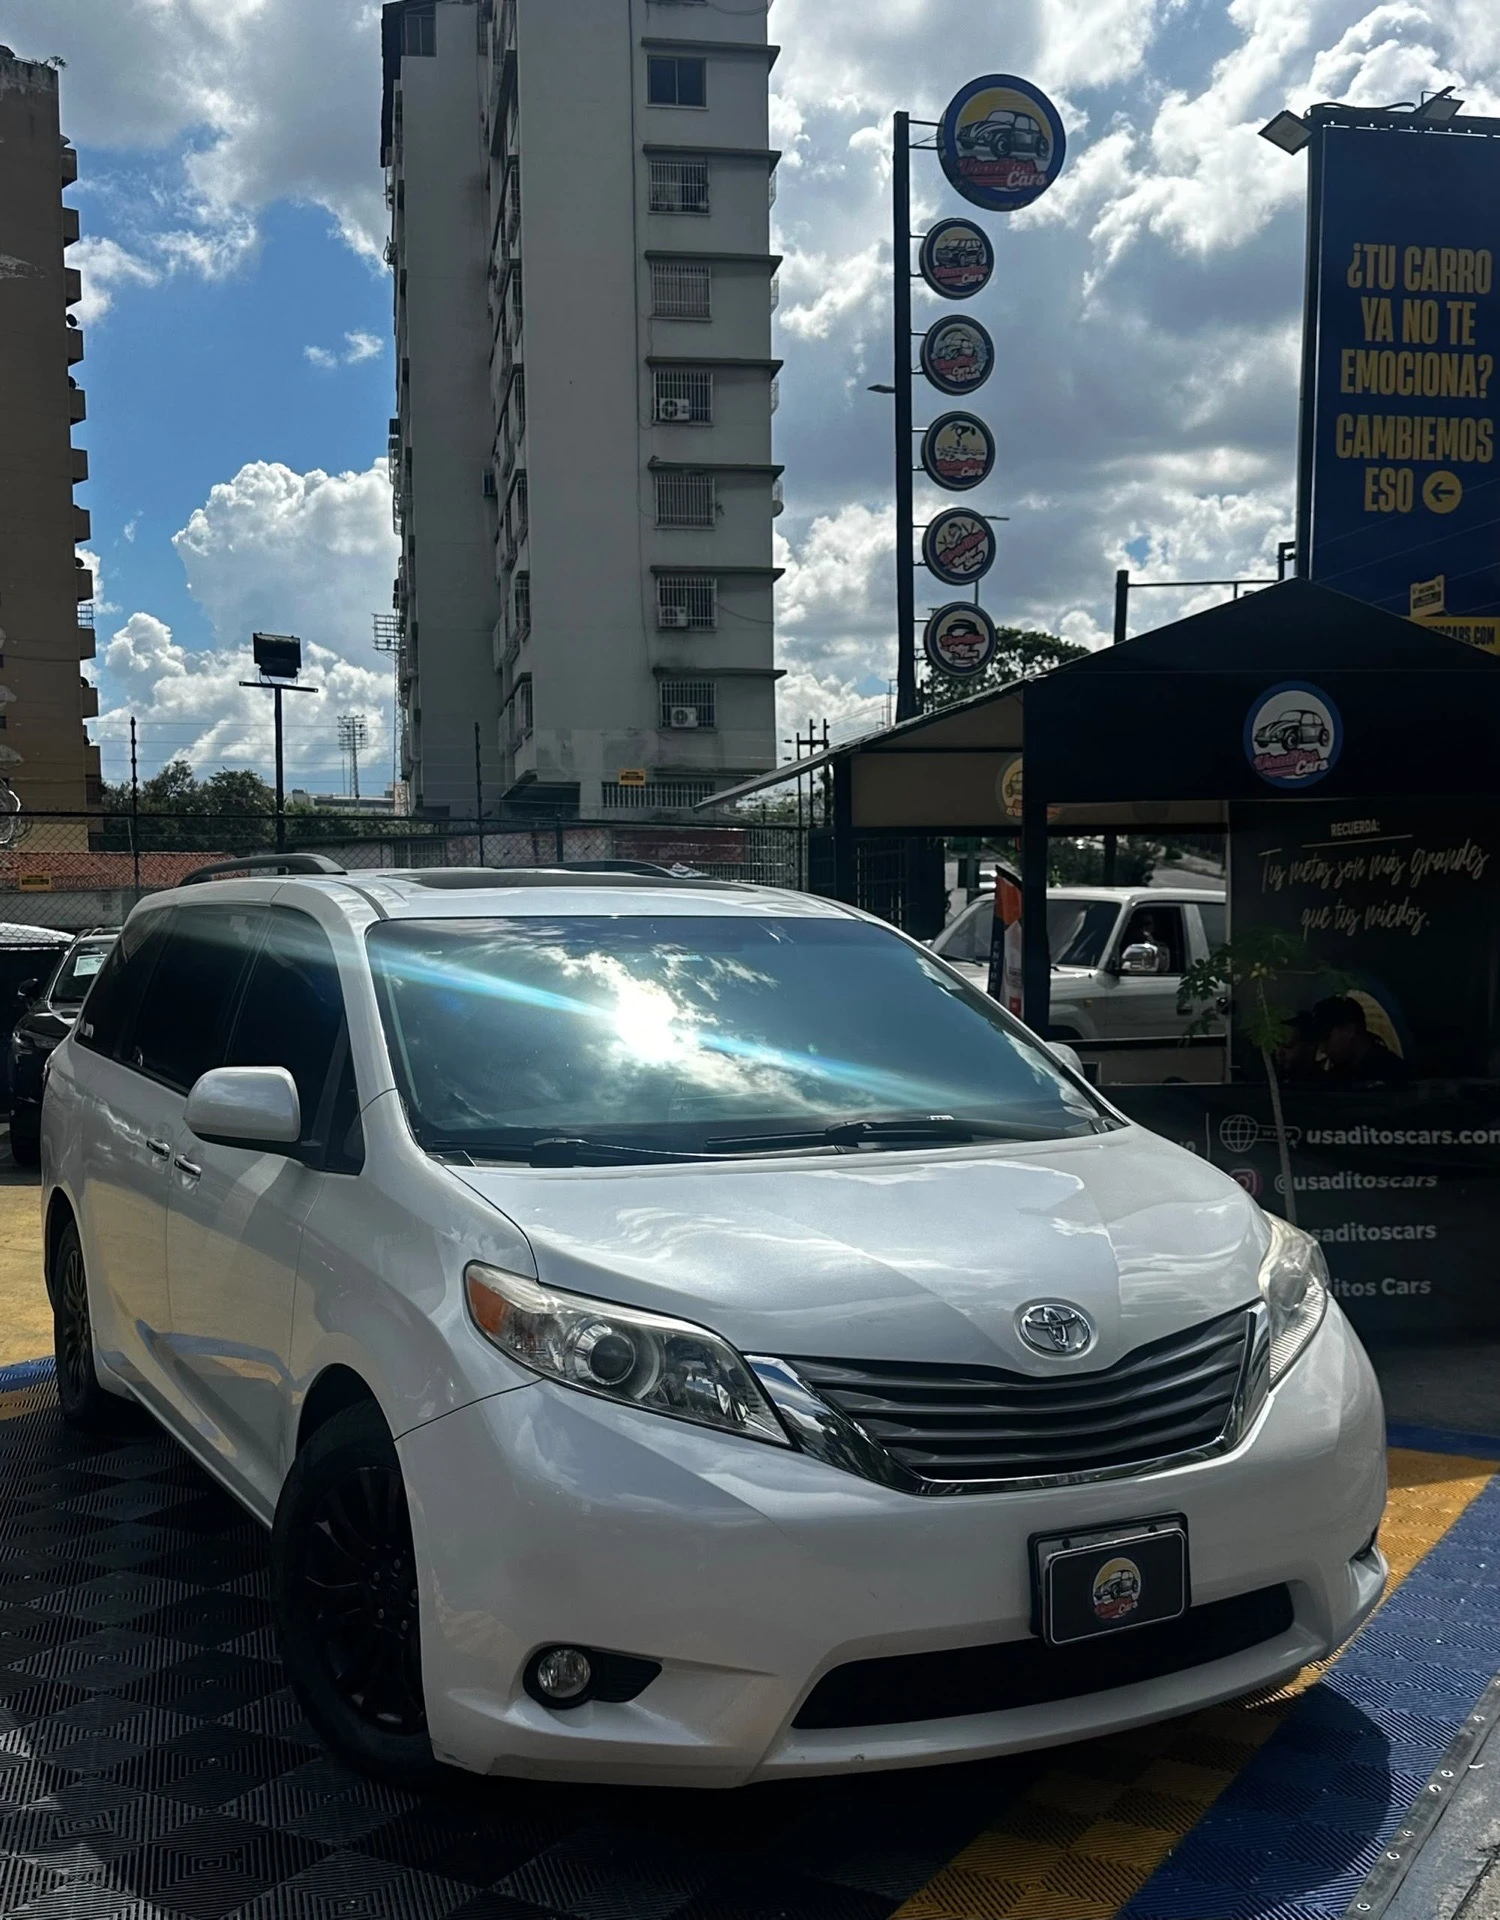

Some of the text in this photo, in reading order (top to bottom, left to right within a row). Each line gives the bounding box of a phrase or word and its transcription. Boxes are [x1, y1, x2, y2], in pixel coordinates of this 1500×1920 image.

[1006, 171, 1046, 187] Cars
[1347, 243, 1492, 294] ¿TU CARRO
[1361, 296, 1477, 345] YA NO TE
[1340, 349, 1494, 399] EMOCIONA?
[1335, 413, 1494, 463] CAMBIEMOS
[1364, 467, 1414, 513] ESO
[1295, 760, 1329, 775] Cars
[1330, 819, 1381, 837] RECUERDA:
[1258, 848, 1287, 893] Tus
[1289, 852, 1336, 889] metas
[1332, 856, 1368, 889] son
[1369, 849, 1408, 886] más
[1301, 896, 1431, 942] que tus miedos.
[1304, 1222, 1438, 1243] saditoscars
[1328, 1278, 1432, 1297] itos Cars
